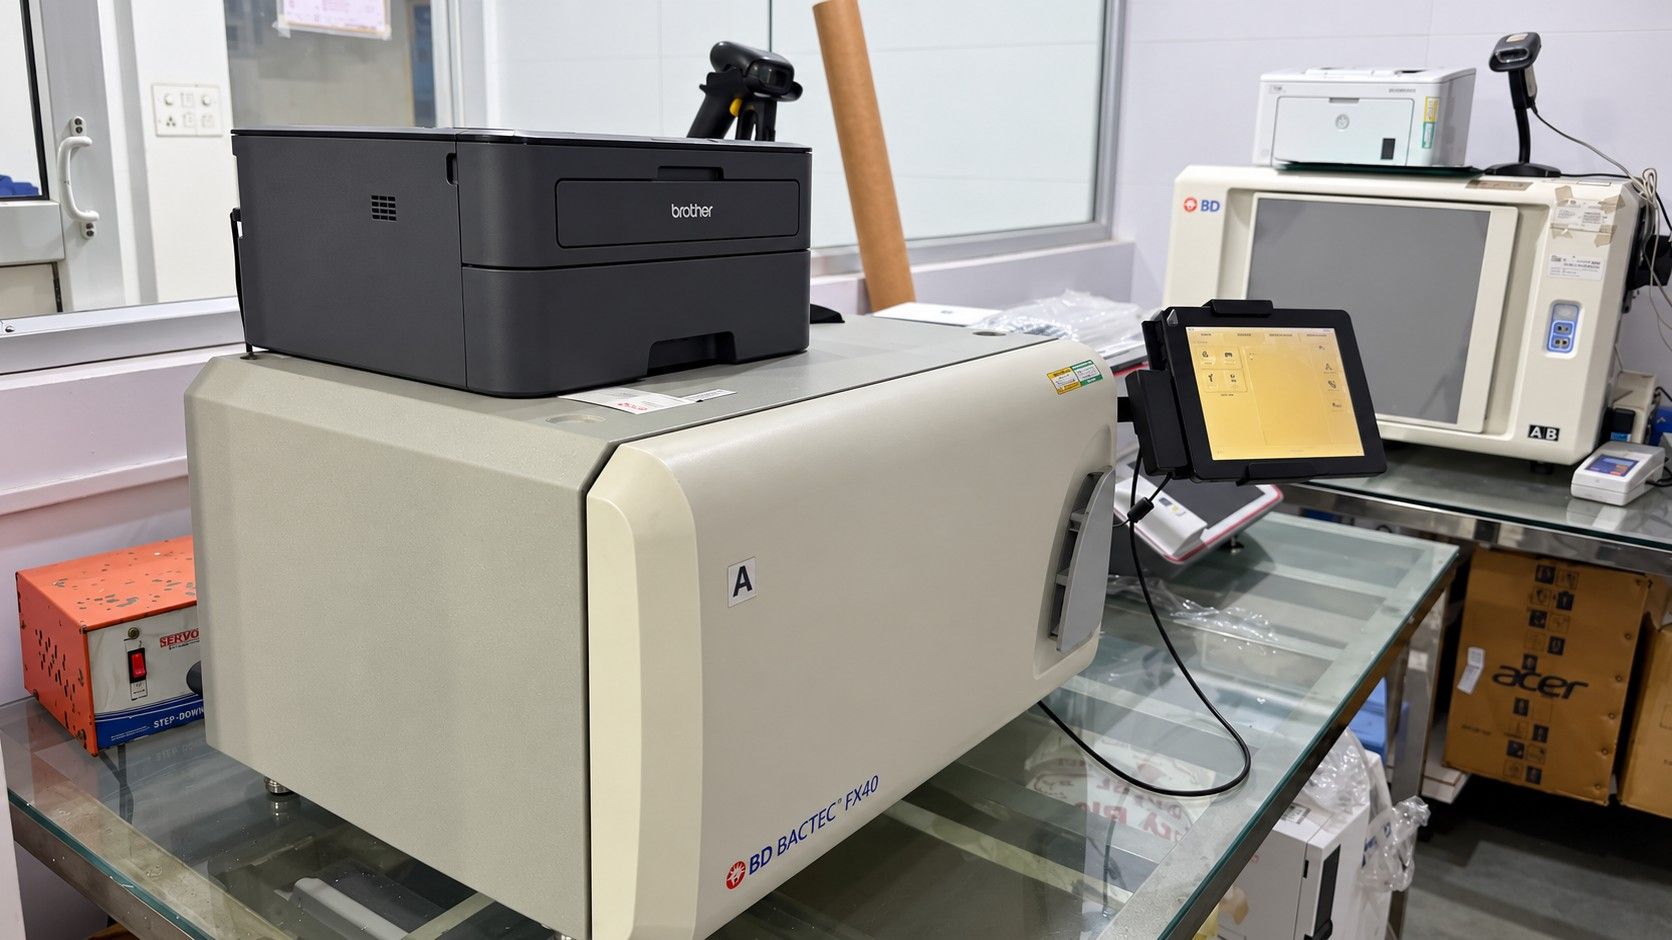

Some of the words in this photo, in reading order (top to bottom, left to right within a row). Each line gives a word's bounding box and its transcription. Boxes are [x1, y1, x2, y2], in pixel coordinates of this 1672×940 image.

[671, 203, 713, 218] brother
[1201, 200, 1220, 212] BD
[733, 565, 753, 598] A
[160, 628, 199, 648] SERVO
[1492, 665, 1589, 700] acer
[749, 846, 772, 875] BD
[845, 774, 879, 811] FX40
